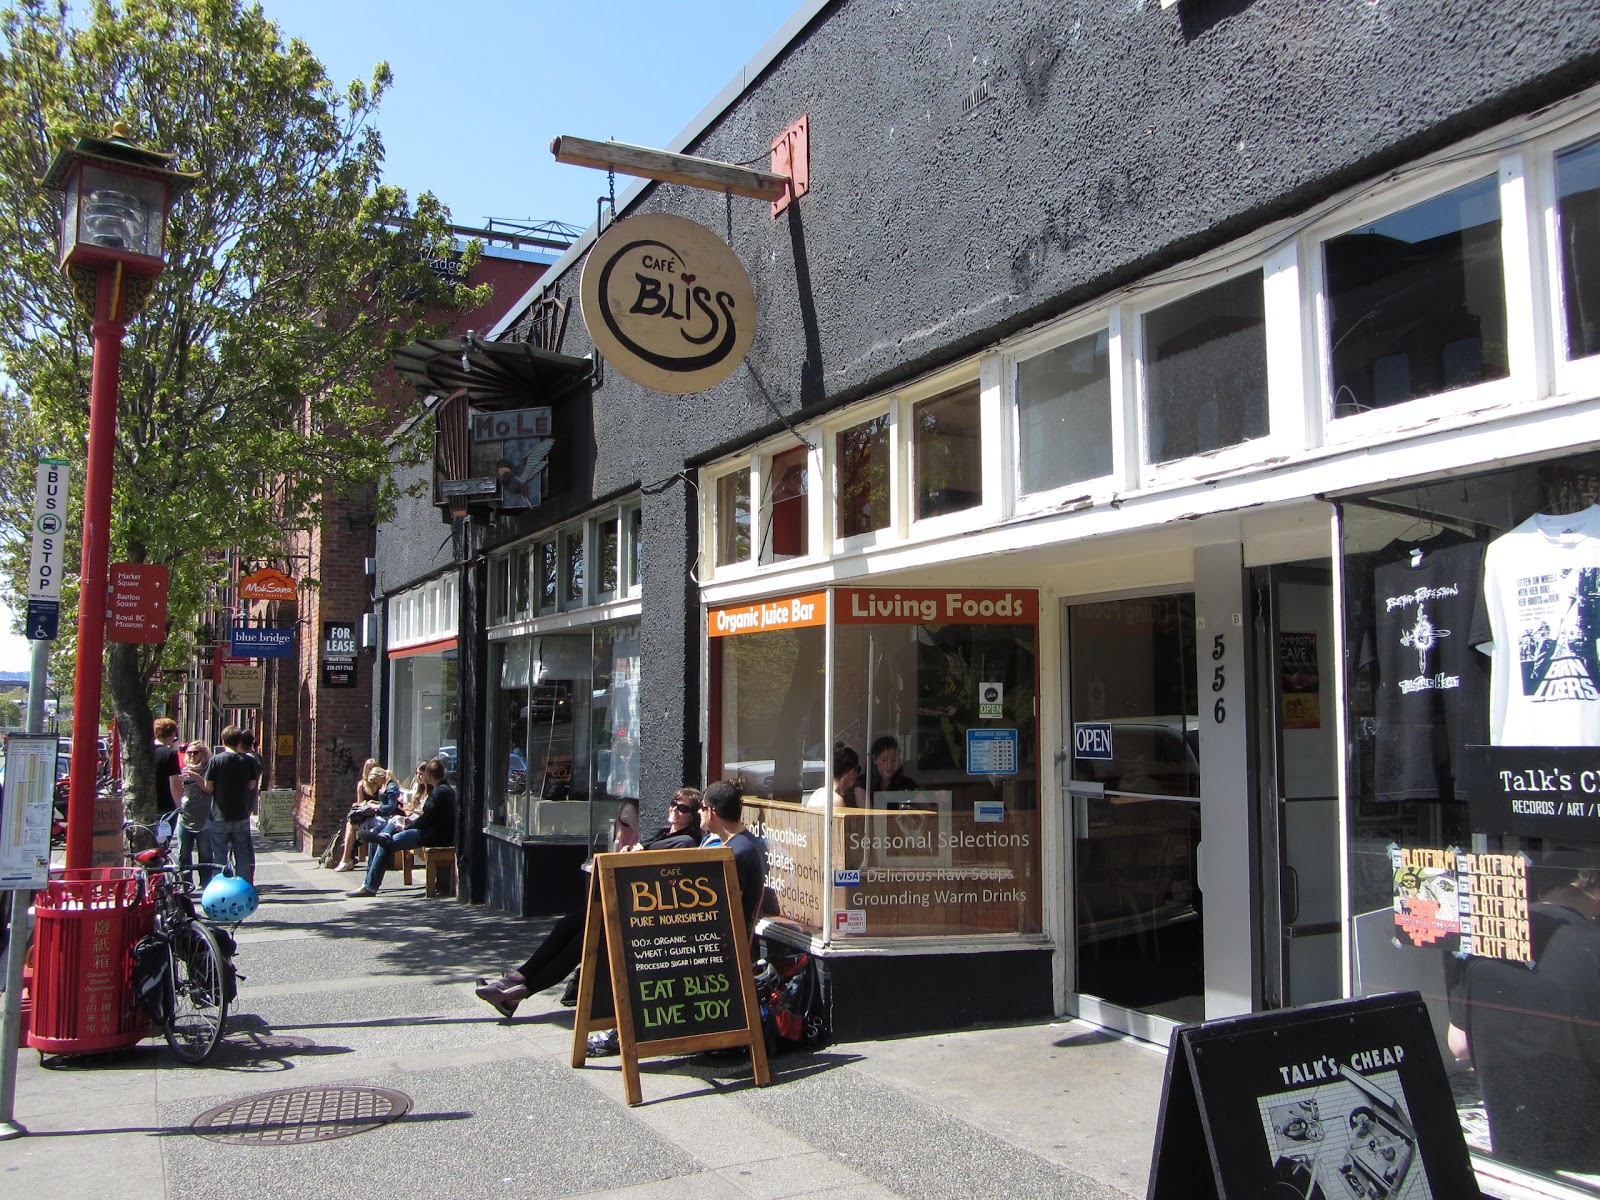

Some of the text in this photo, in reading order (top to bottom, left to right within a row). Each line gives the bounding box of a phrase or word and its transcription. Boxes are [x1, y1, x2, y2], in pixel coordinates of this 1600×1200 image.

[642, 255, 675, 273] CAFÉ
[46, 472, 58, 510] BUS
[40, 538, 53, 590] STOP
[118, 572, 141, 580] Market
[115, 613, 133, 621] Royal
[716, 600, 814, 633] Organic Juice Bar
[852, 593, 1023, 621] Living Foods
[235, 631, 290, 645] blue bridge
[331, 627, 350, 639] FOR
[1279, 635, 1316, 647] AMMOTH
[326, 640, 354, 652] LEASE
[980, 704, 1003, 714] OPEN
[1076, 728, 1111, 752] OPEN
[1499, 768, 1600, 794] Talk's C
[1512, 800, 1555, 816] RECORDS
[1567, 801, 1584, 817] ART
[761, 821, 807, 848] Smoothies
[849, 831, 1029, 850] Seasonal Selections
[1400, 847, 1456, 870] PLATFORM
[1467, 853, 1525, 877] PLATFORM
[660, 867, 682, 878] CAFÉ
[838, 872, 858, 880] VISA
[867, 868, 1014, 884] Delicious Raw Soups
[1468, 874, 1527, 898] PLATFORM
[852, 887, 1027, 908] Grounding Warm Drinks
[1469, 895, 1528, 920] PLATFORM
[630, 910, 719, 928] PURE NOURISHMENT
[1470, 915, 1530, 941] PLATFORM
[631, 932, 721, 948] 100% ORGANIC LOCAL
[1471, 935, 1531, 962] PLATFORM
[634, 948, 662, 959] WHEAT
[669, 945, 696, 956] GLUTEN
[698, 943, 720, 953] FREE
[635, 961, 669, 972] PROCESSED
[670, 959, 688, 968] SUGAR
[693, 956, 709, 965] DAIRY
[709, 955, 724, 964] FREE
[640, 978, 676, 1001] EAT
[643, 999, 731, 1028] LIVE JOY
[1279, 1045, 1404, 1086] TALK'S CHEAP
